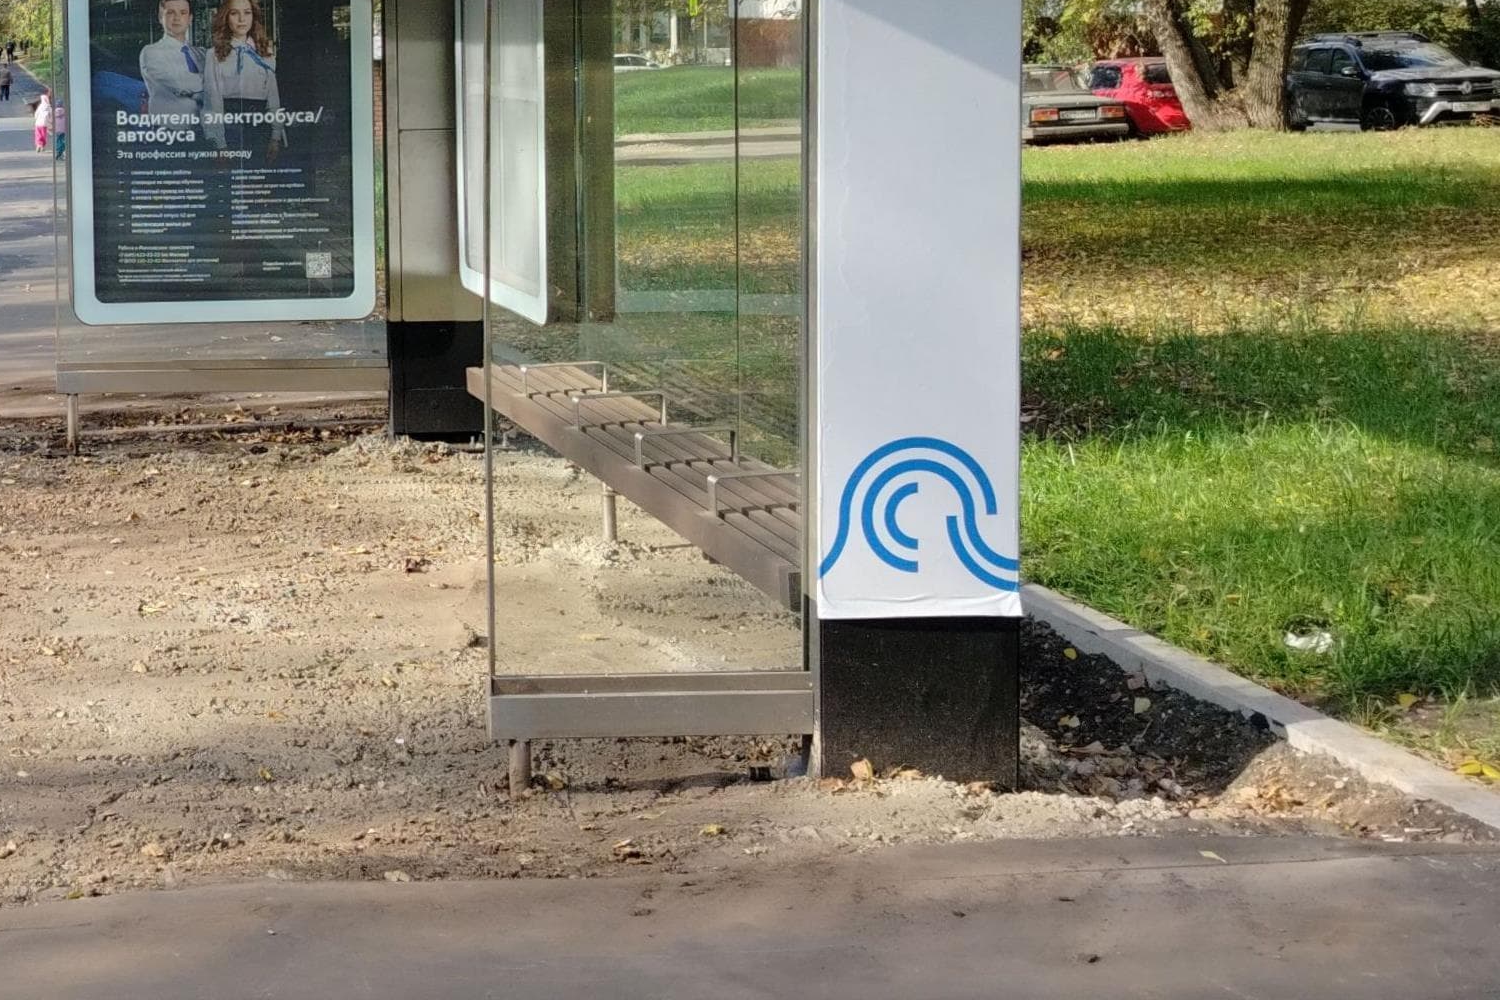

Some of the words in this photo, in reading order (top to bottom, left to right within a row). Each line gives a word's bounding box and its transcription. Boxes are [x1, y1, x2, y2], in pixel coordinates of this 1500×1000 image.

[116, 110, 200, 127] Водитель
[203, 106, 324, 127] электробуса/
[116, 127, 196, 145] автобуса
[117, 150, 133, 159] Эта
[135, 149, 186, 160] профессия
[188, 150, 217, 160] нужна
[219, 150, 253, 160] городу
